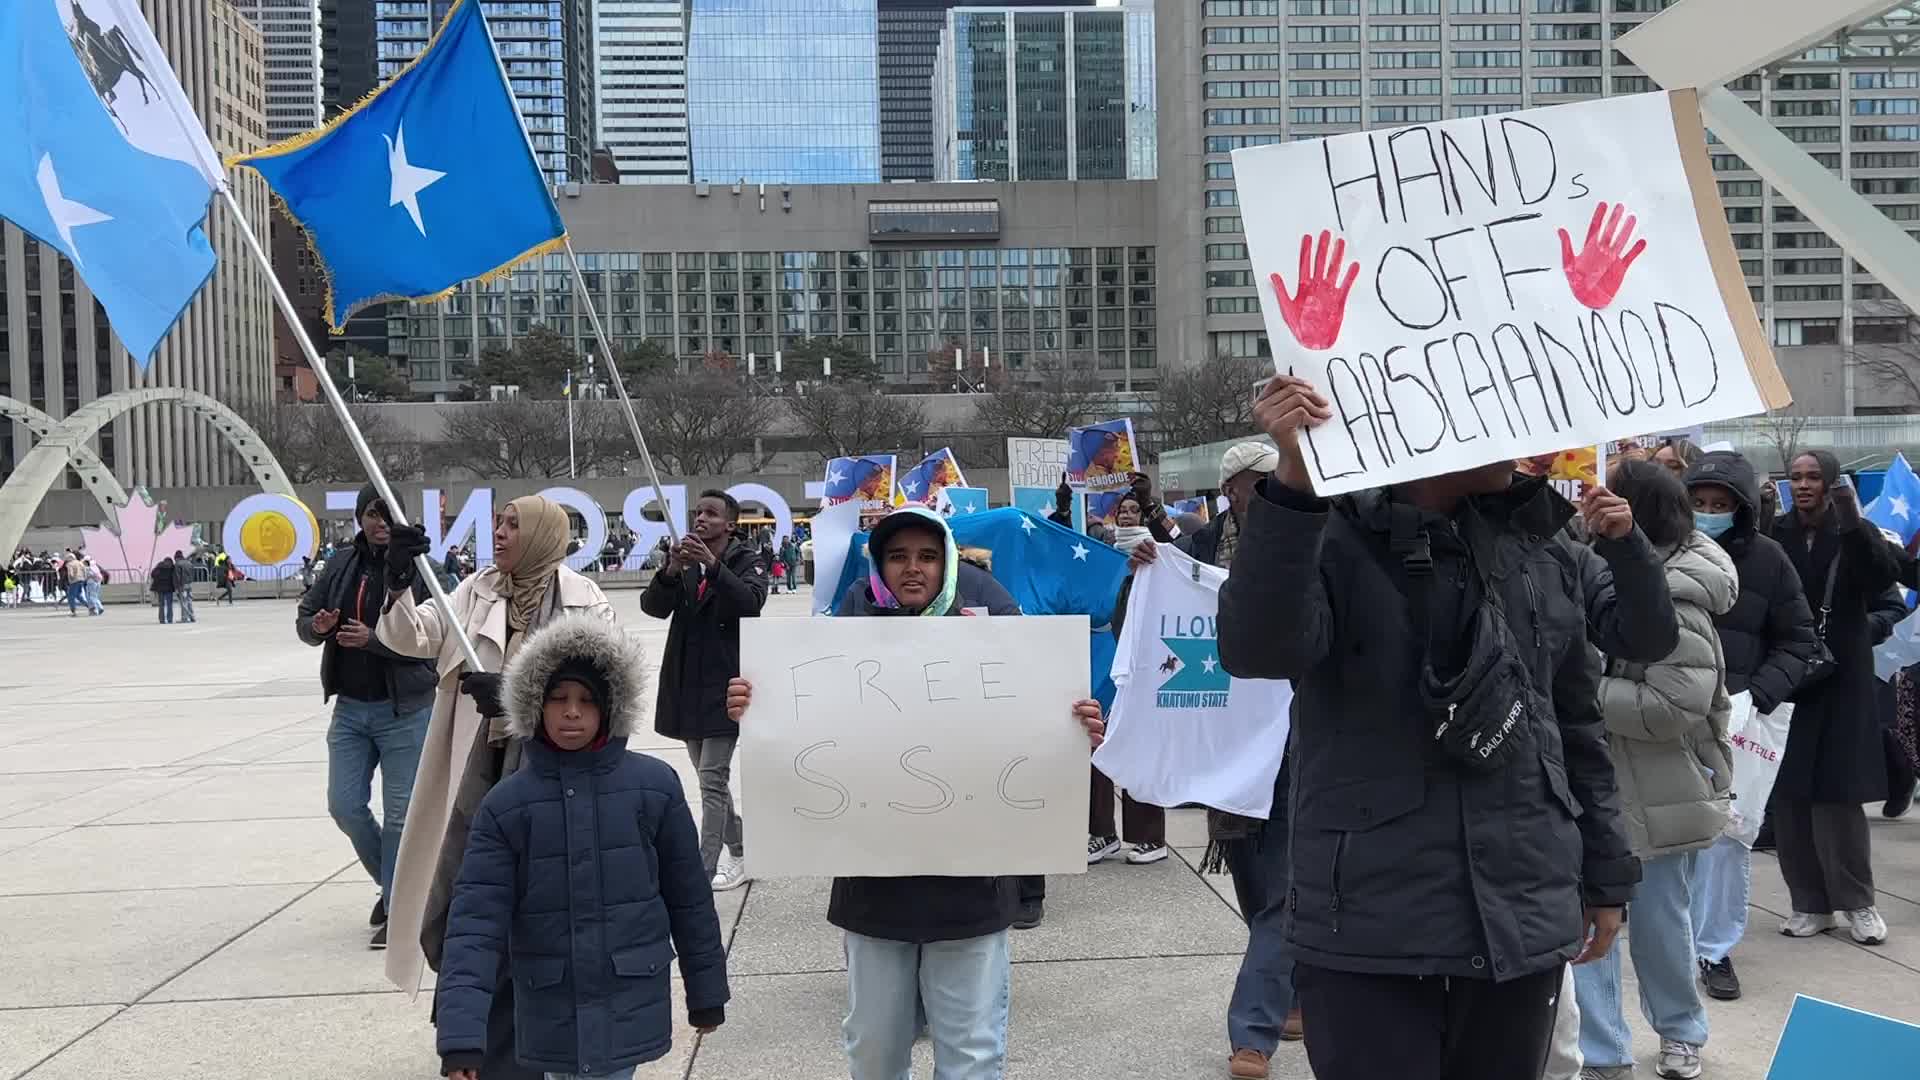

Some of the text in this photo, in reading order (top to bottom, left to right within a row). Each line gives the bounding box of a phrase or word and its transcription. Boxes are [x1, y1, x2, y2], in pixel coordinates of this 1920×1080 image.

[1375, 212, 1551, 330] OFF
[1015, 439, 1067, 465] FREE
[1160, 614, 1218, 638] I LOV
[789, 654, 1017, 721] FREE
[1156, 692, 1229, 708] KHATUMO STATE
[1479, 700, 1524, 758] DAILY PAPER
